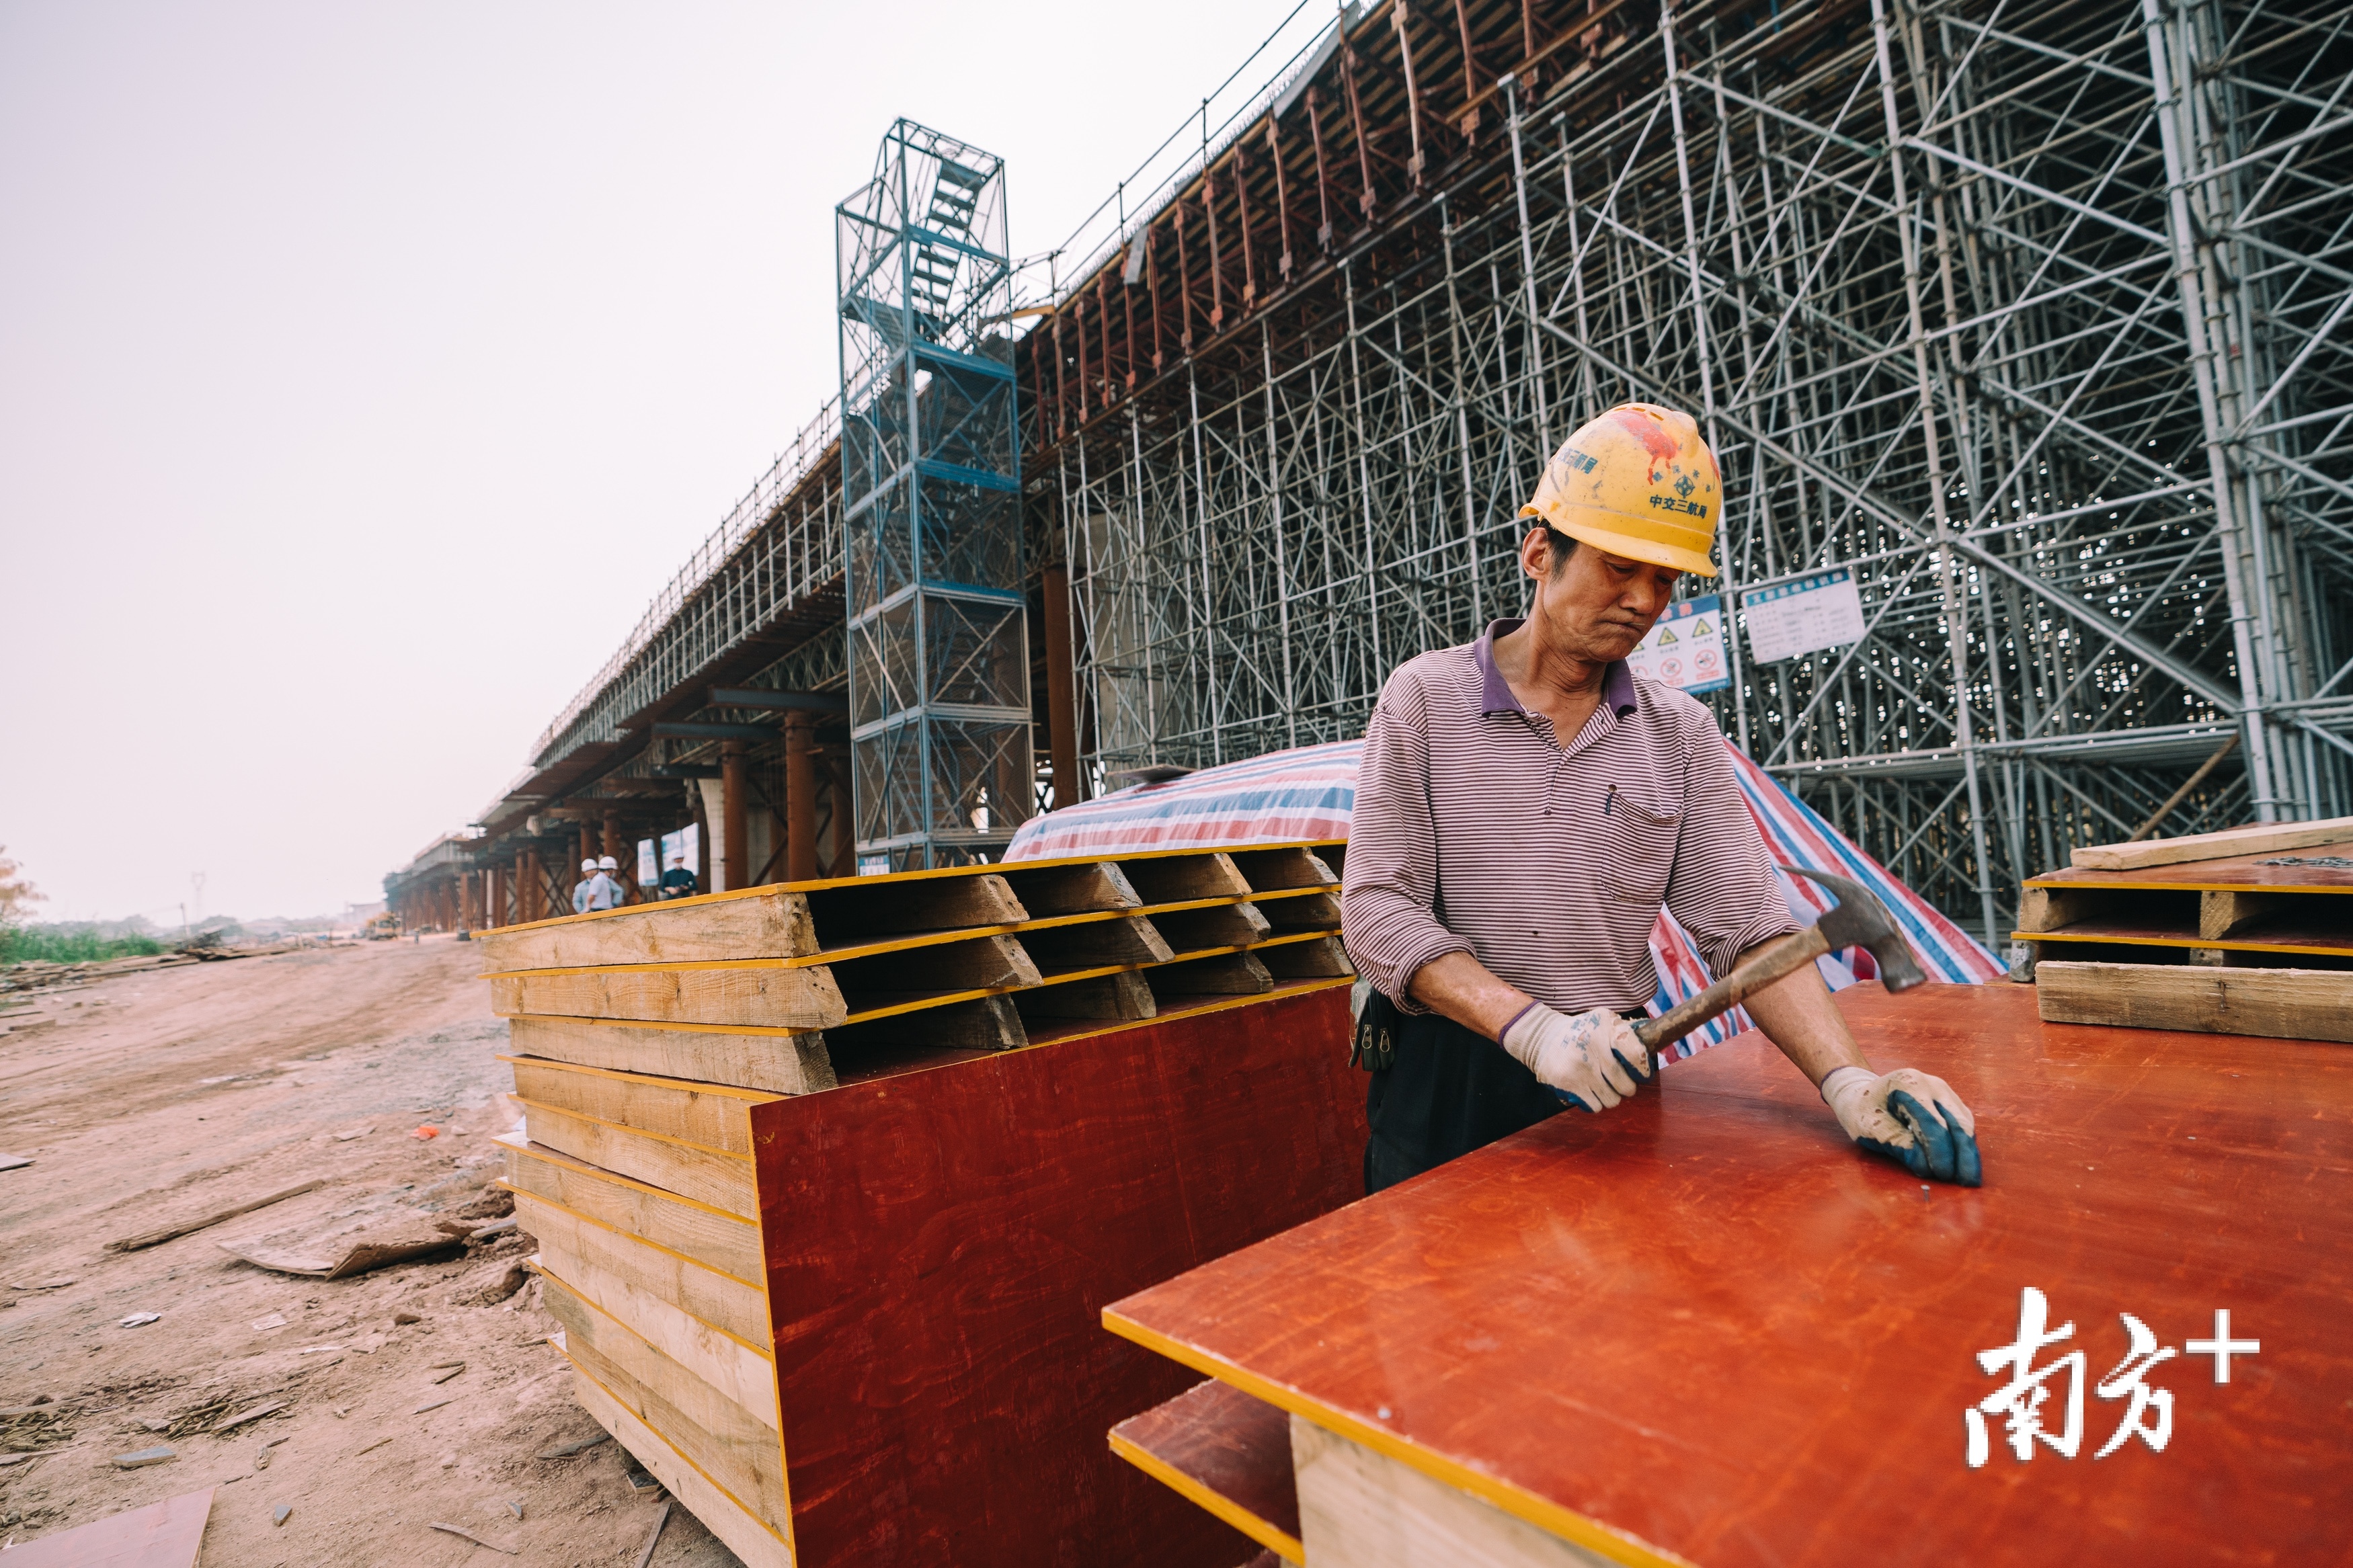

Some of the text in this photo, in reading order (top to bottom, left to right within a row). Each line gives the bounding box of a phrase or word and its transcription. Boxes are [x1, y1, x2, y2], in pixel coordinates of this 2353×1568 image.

[1649, 494, 1708, 519] 中交三航局
